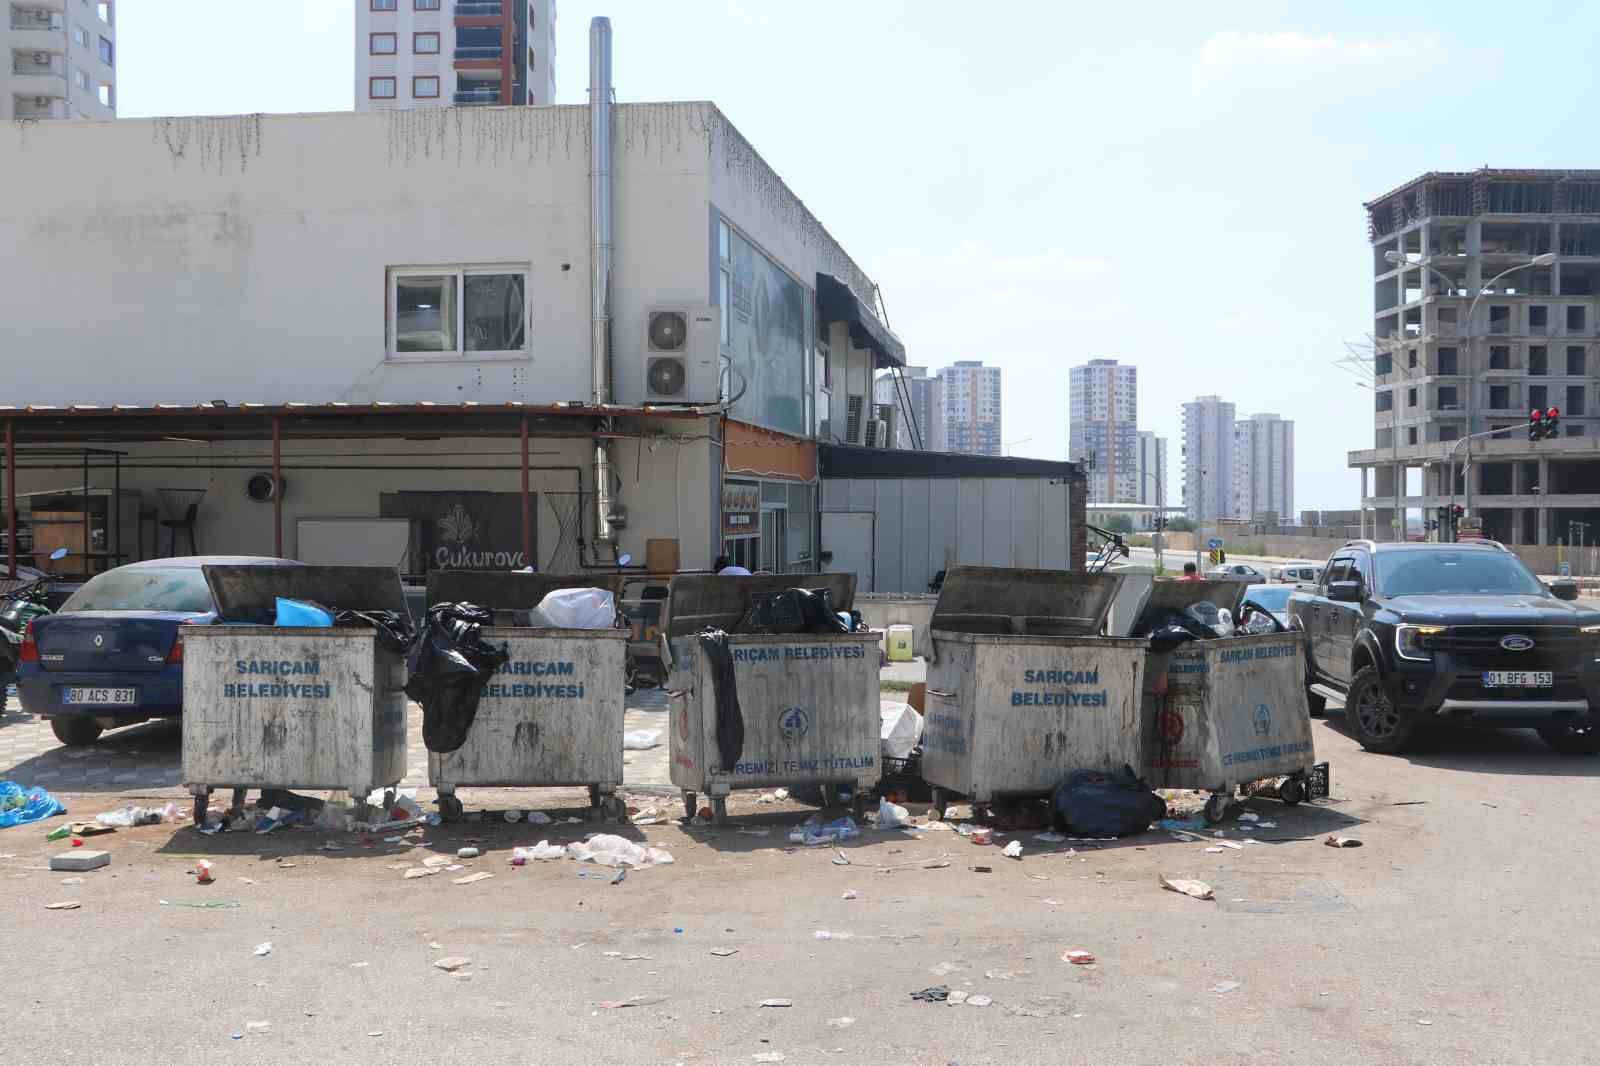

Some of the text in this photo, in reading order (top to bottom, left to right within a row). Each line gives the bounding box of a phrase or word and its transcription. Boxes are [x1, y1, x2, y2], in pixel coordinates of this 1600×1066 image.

[729, 647, 780, 663] RIÇAM
[1488, 672, 1501, 684] 01
[1534, 672, 1551, 684] 153
[88, 689, 109, 701] ACS
[114, 689, 135, 701] 831
